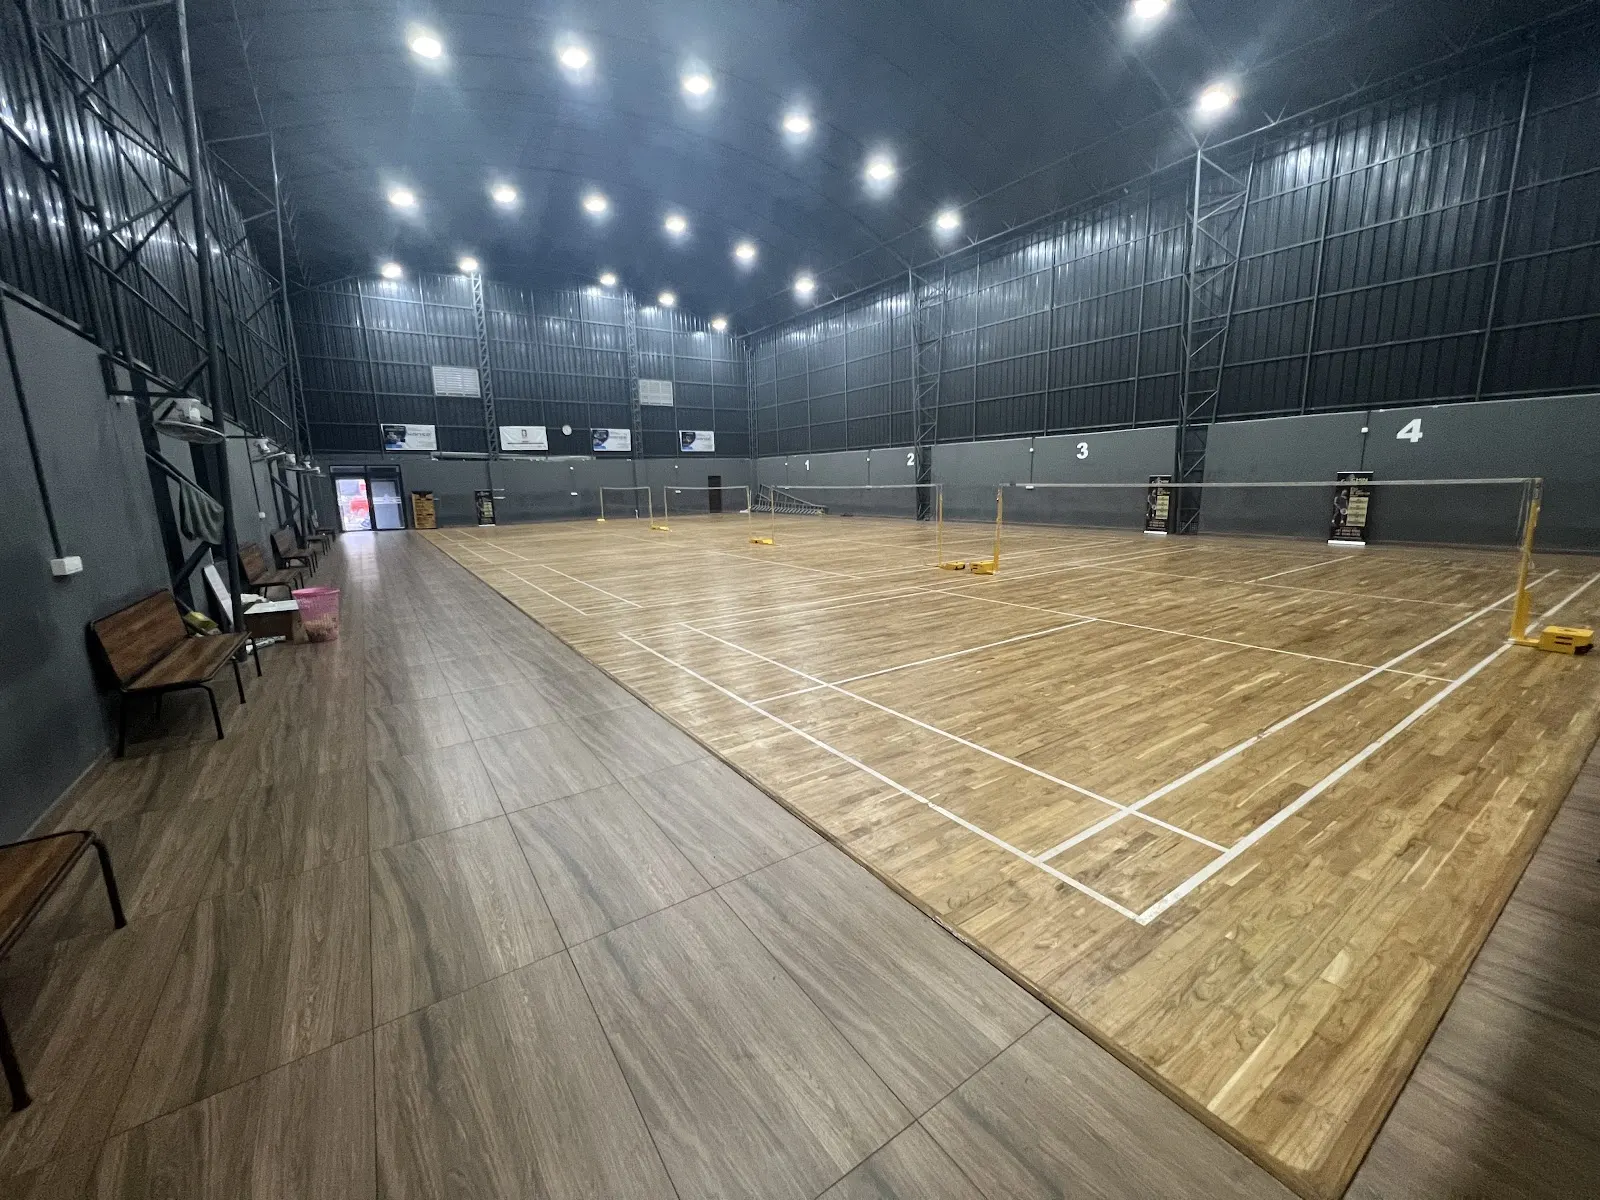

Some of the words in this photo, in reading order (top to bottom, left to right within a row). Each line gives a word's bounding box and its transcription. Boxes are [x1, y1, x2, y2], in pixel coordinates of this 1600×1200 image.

[1396, 418, 1423, 443] 4
[906, 452, 915, 466] 2
[1076, 442, 1088, 460] 3
[804, 459, 810, 471] 1
